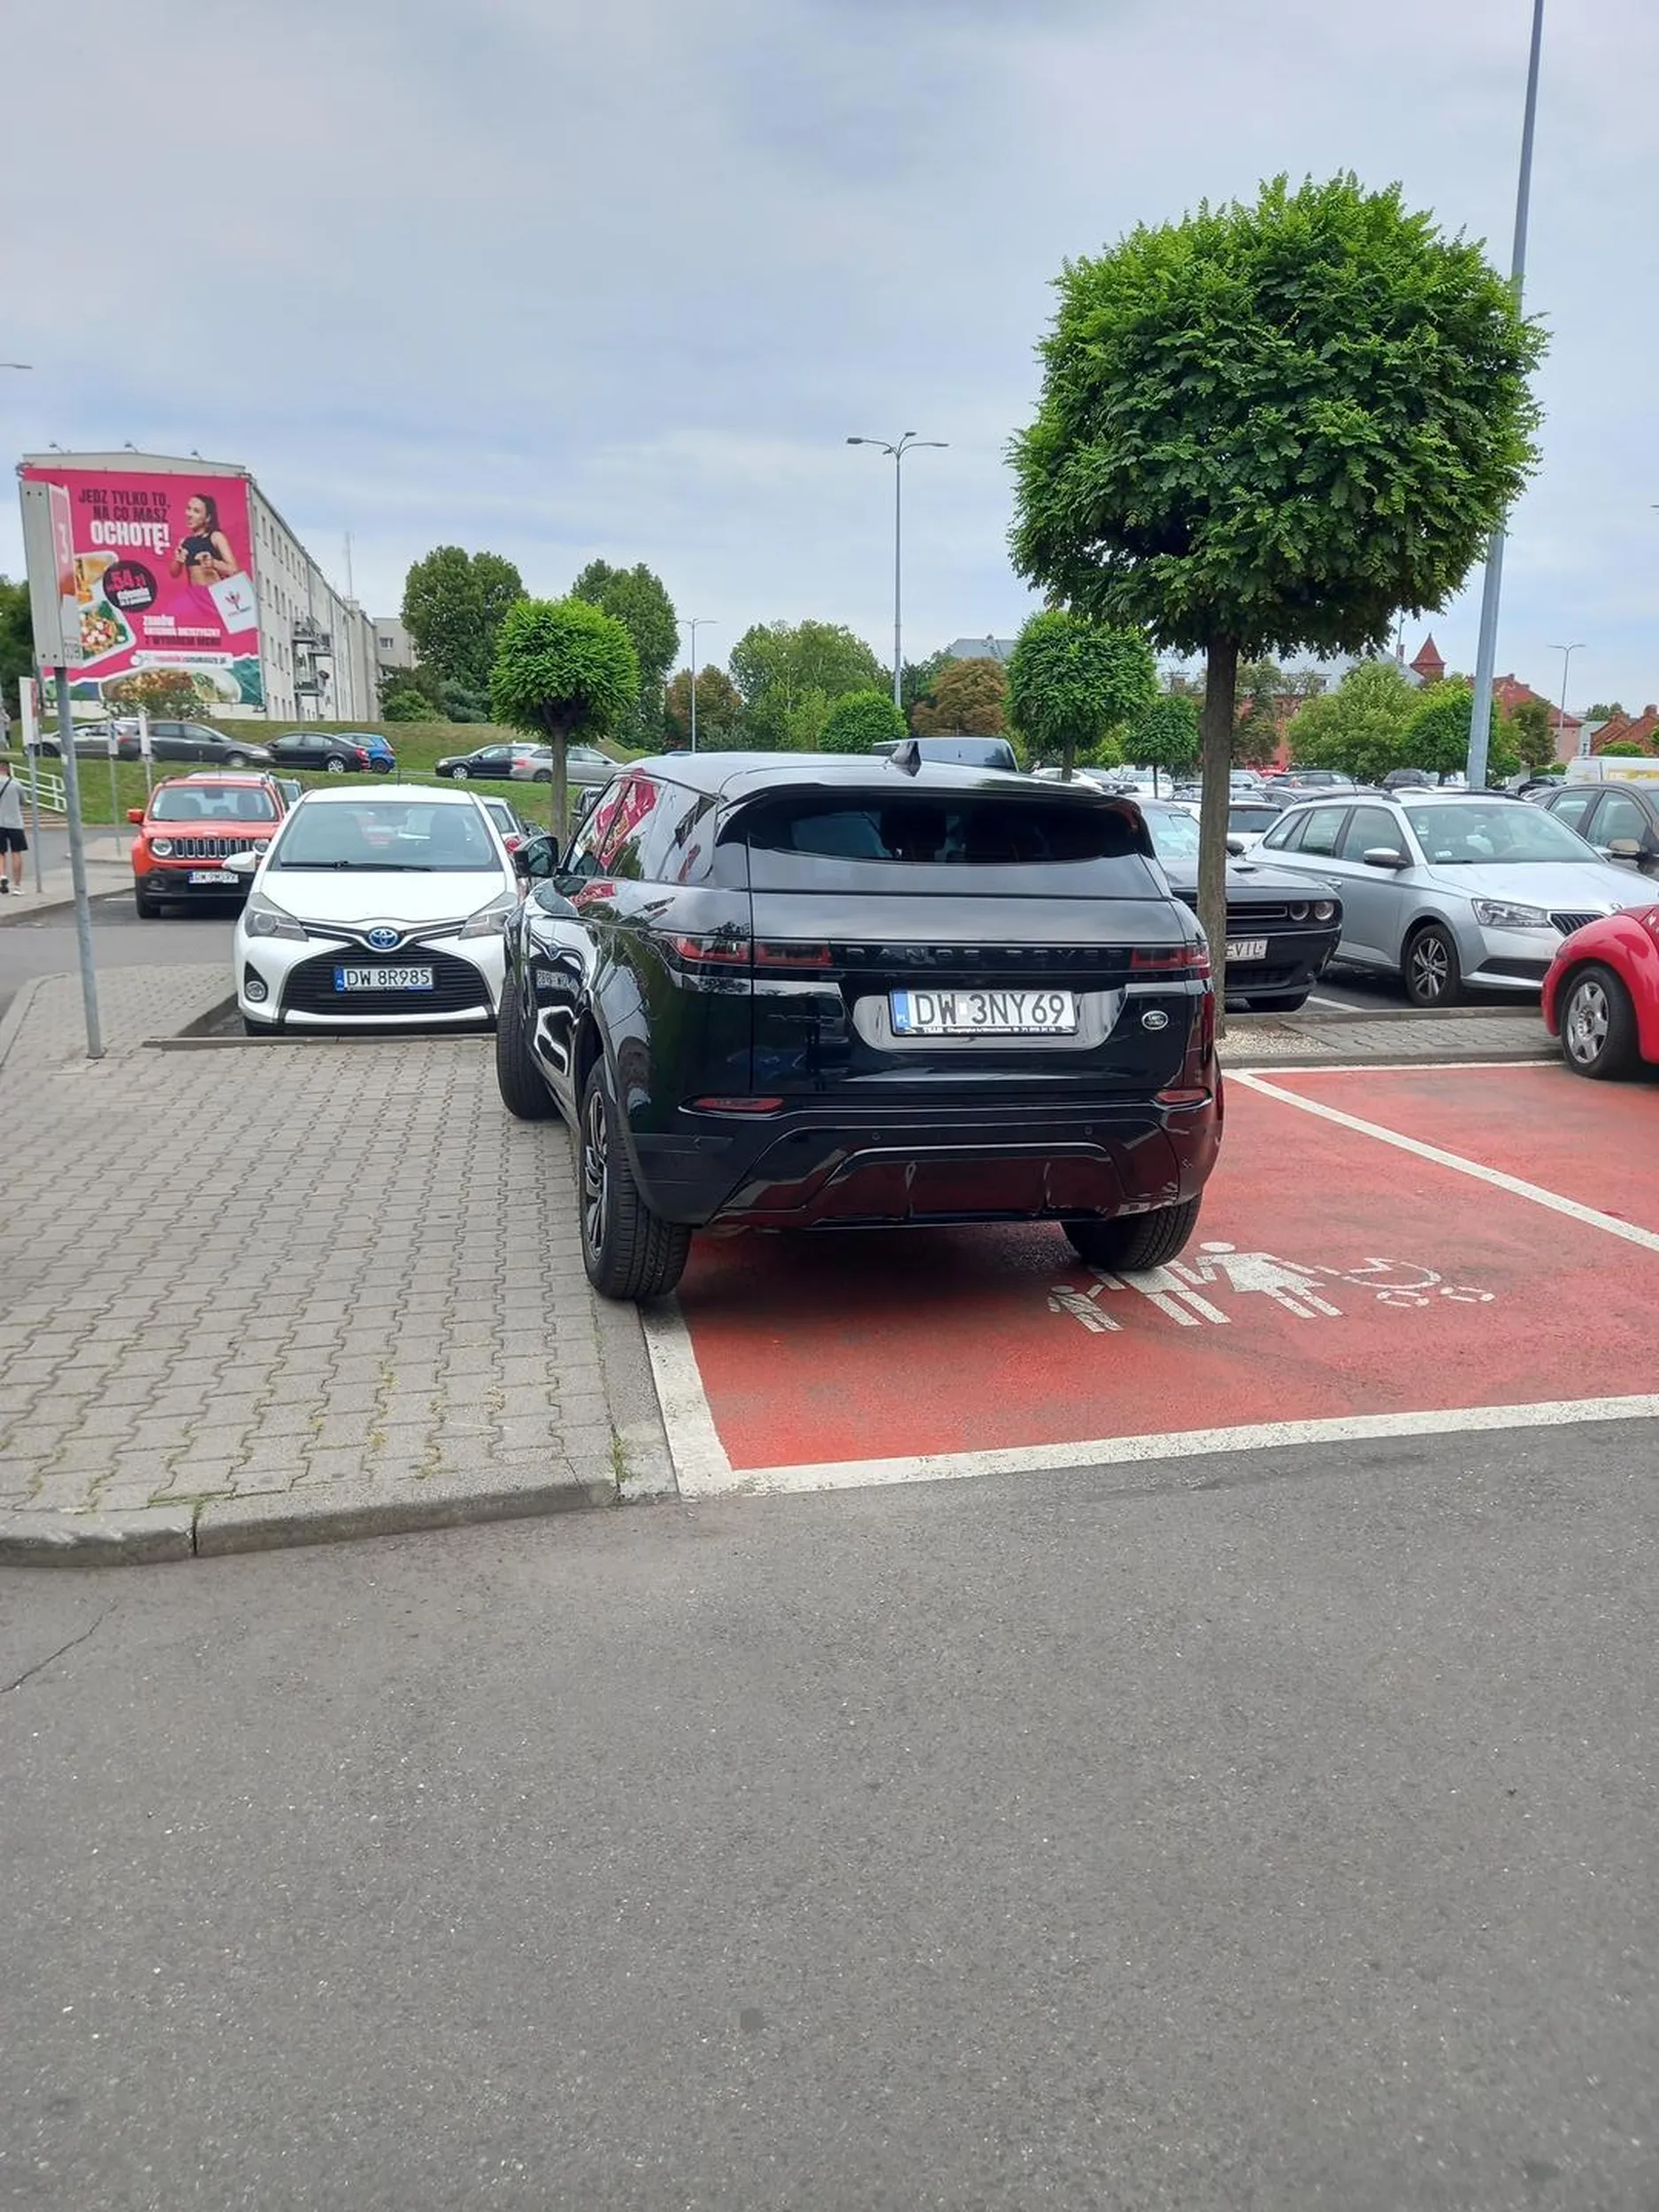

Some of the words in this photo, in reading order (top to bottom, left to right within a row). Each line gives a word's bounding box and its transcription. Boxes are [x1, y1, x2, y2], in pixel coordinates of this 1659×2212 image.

[79, 489, 107, 503] JEDZ
[111, 490, 148, 505] TYLKO
[93, 506, 110, 520] NA
[113, 506, 128, 520] CO
[133, 507, 168, 522] MASZ
[90, 520, 170, 556] OCHOTĘ!
[347, 971, 371, 985] DW
[378, 970, 429, 985] 8R985
[915, 995, 956, 1025] DW
[969, 994, 1065, 1025] 3NY69
